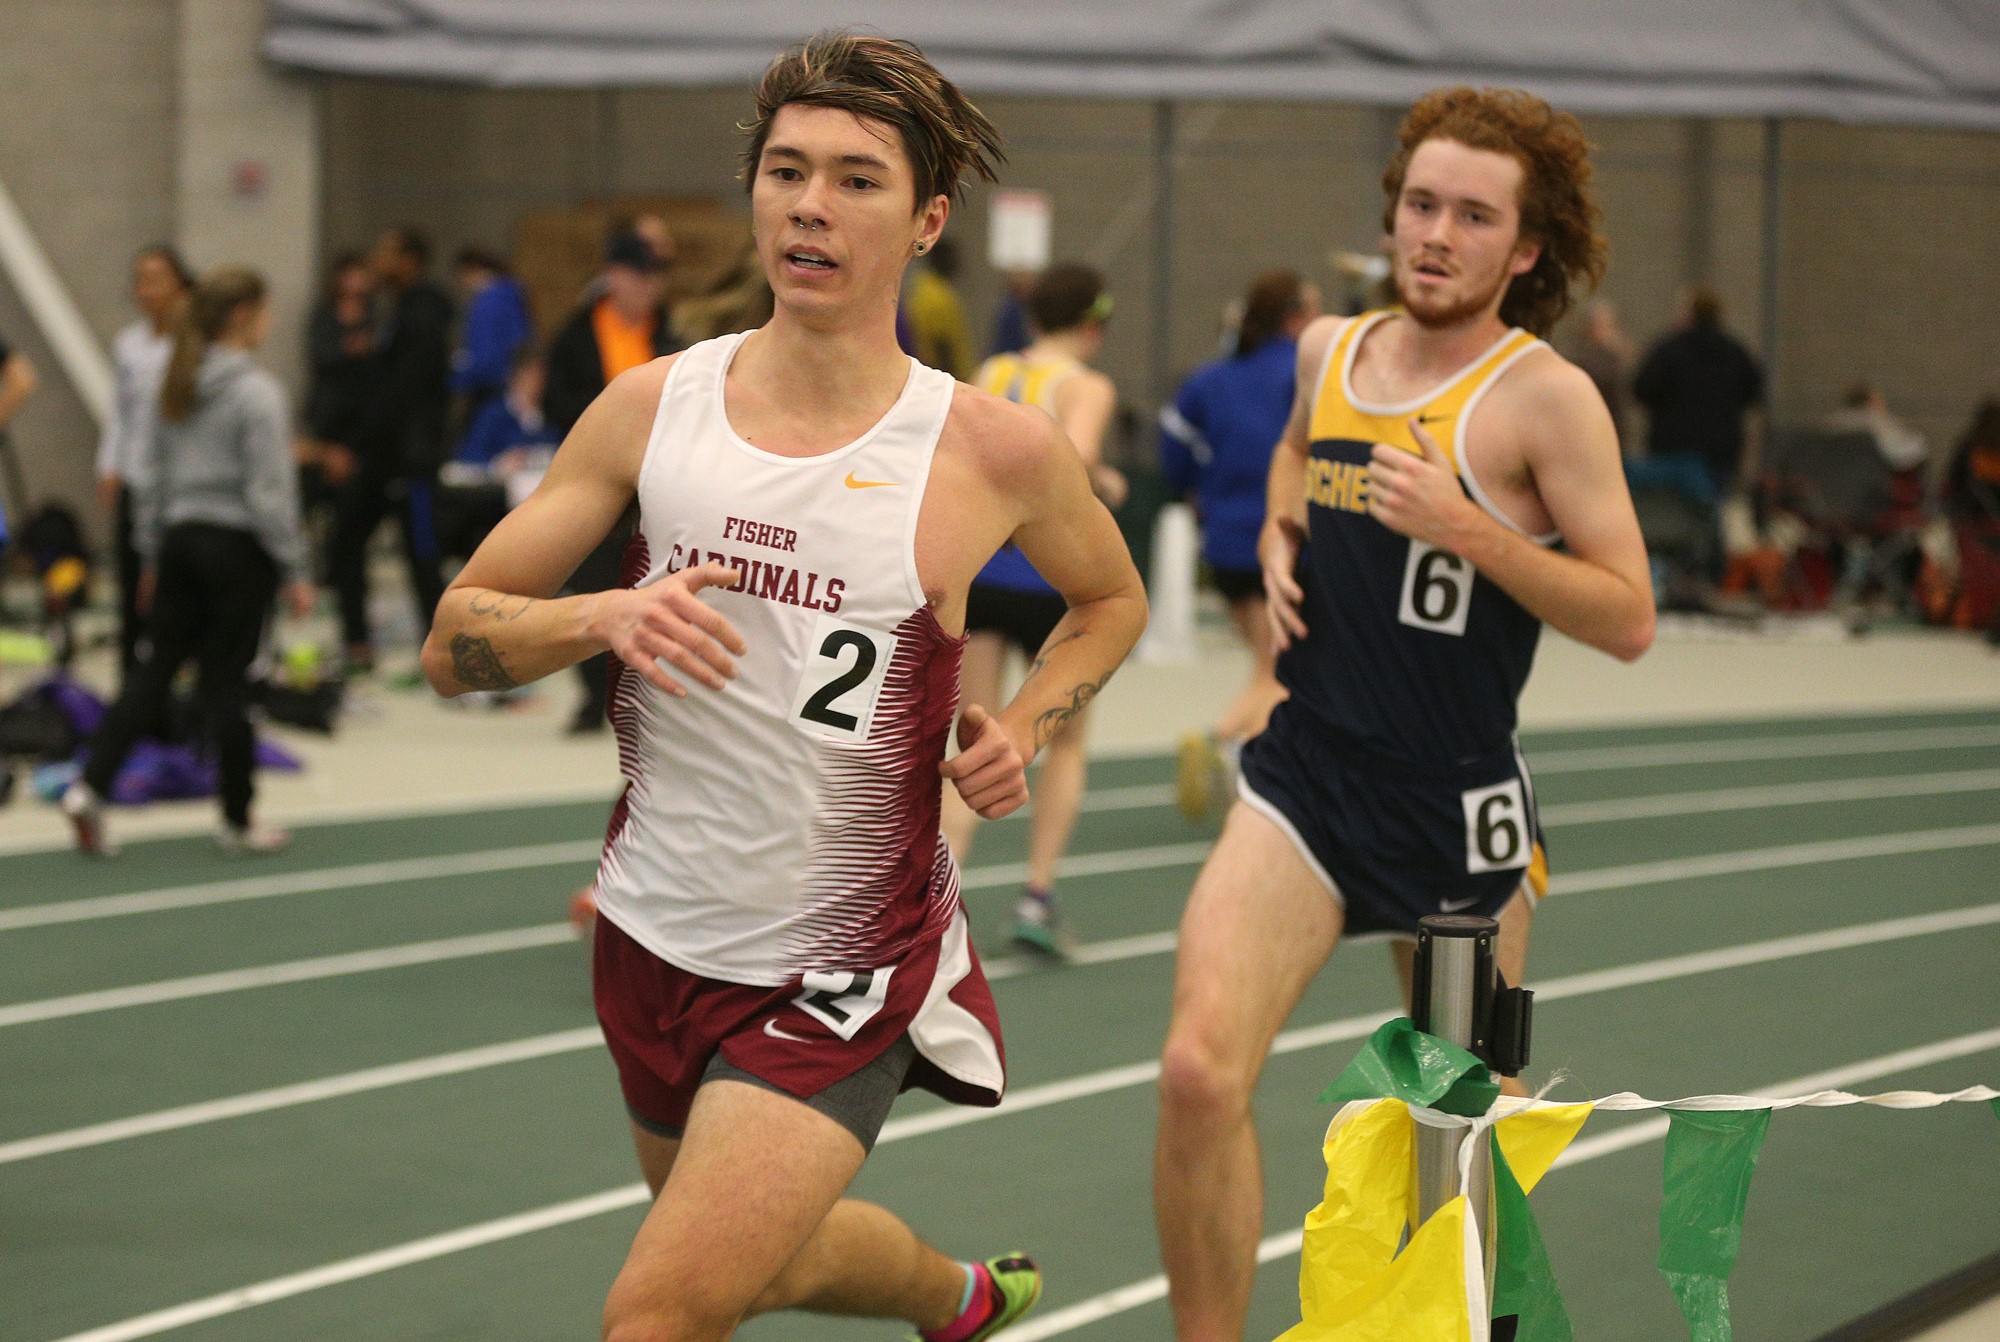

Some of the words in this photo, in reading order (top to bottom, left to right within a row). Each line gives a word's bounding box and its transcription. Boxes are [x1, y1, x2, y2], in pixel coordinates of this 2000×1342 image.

[722, 516, 798, 552] FISHER
[1412, 549, 1462, 622] 6
[800, 629, 877, 733] 2
[1477, 794, 1519, 863] 6
[803, 970, 875, 1026] 2
